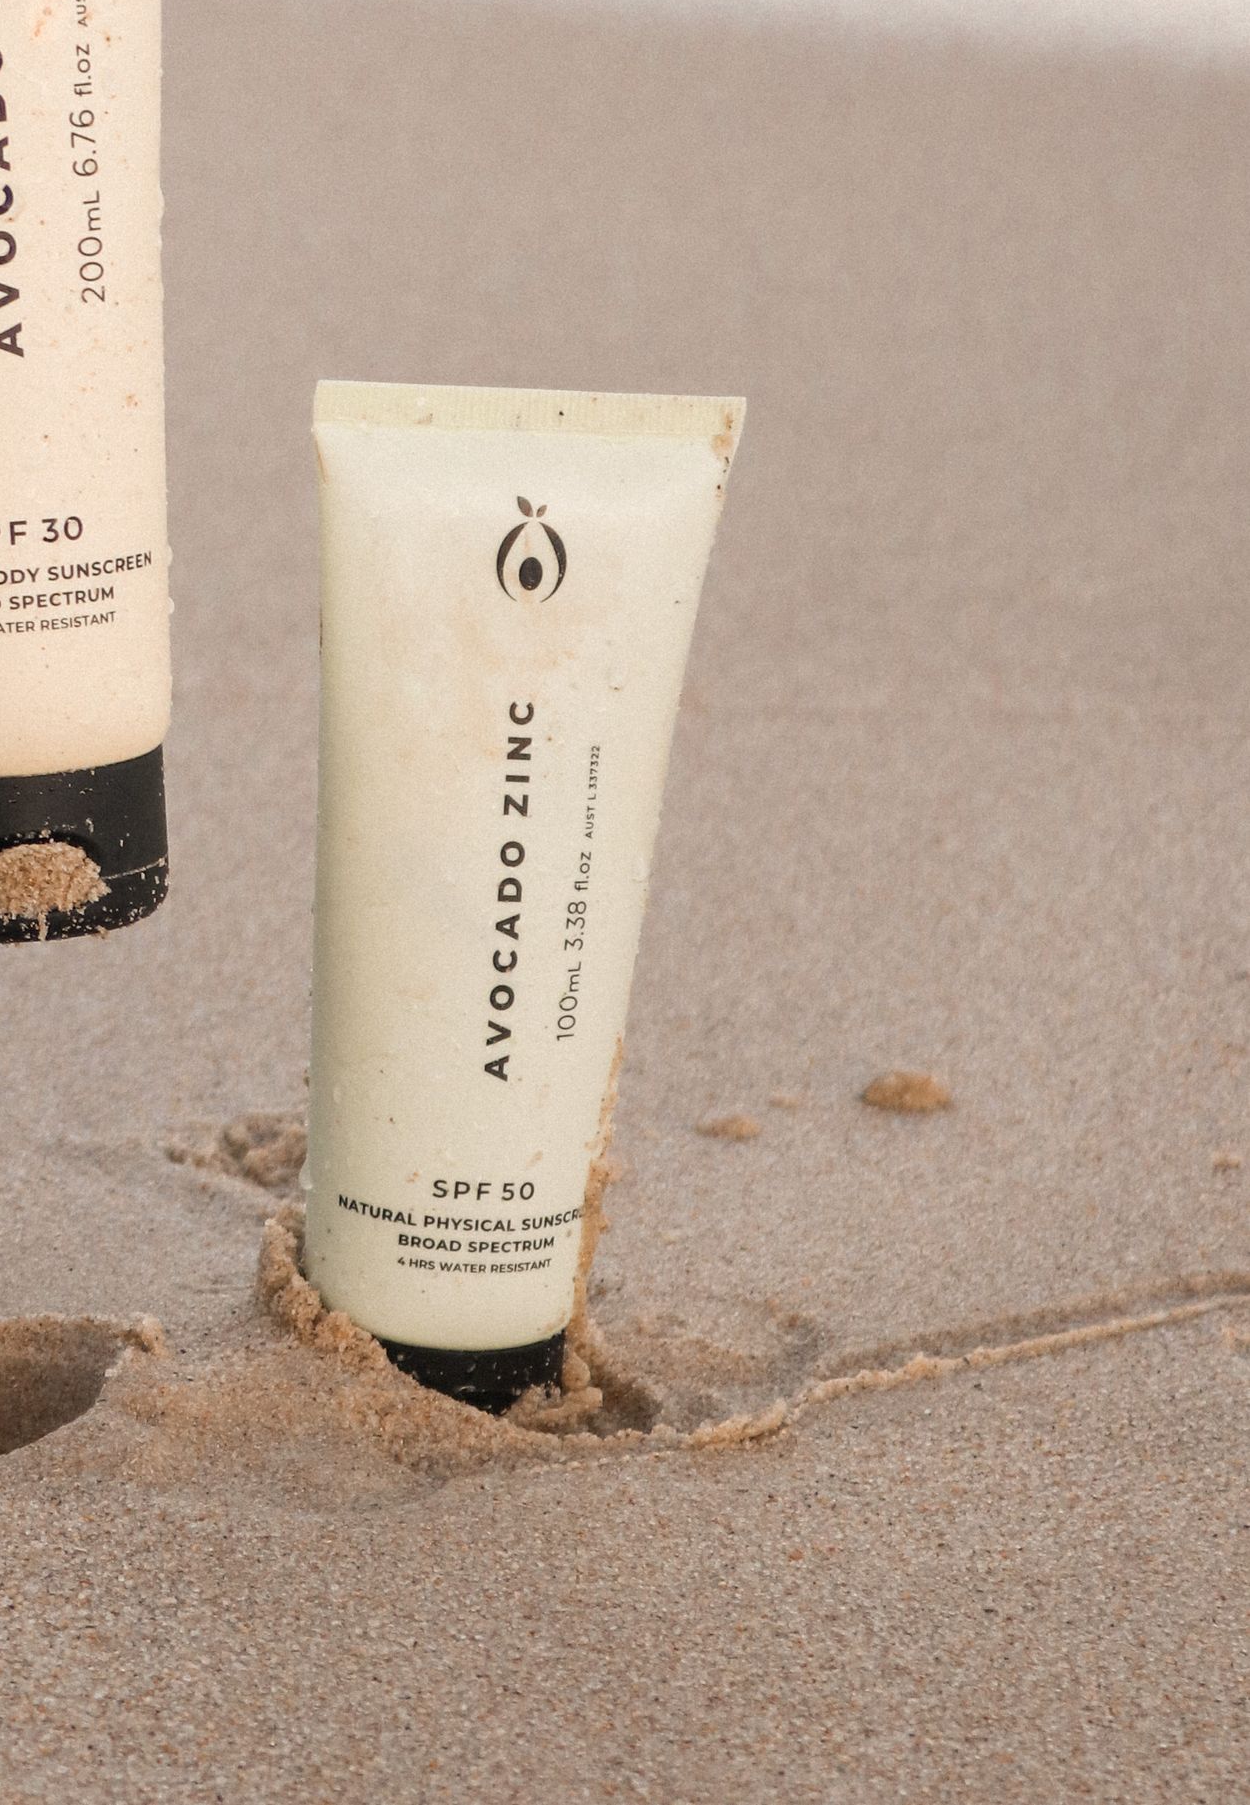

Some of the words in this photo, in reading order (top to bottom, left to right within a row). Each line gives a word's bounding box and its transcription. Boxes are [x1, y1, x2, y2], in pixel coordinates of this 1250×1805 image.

[73, 43, 93, 97] fl.oz
[68, 109, 99, 177] 6.76
[77, 190, 106, 304] 200mL
[41, 515, 83, 544] 30
[47, 551, 152, 582] SUNSCREEN
[8, 586, 115, 611] SPECTRUM
[40, 610, 116, 632] RESISTANT
[502, 701, 535, 818] ZINC
[588, 745, 601, 790] 337322
[586, 793, 597, 801] L
[584, 805, 596, 840] AUST
[573, 851, 592, 892] fl.oz
[563, 900, 587, 951] 3.38
[483, 840, 526, 1082] AVOCADO
[556, 961, 582, 1042] 100mL
[432, 1179, 492, 1201] SPF
[501, 1181, 535, 1202] 50
[338, 1194, 417, 1227] NATURAL
[423, 1214, 516, 1233] PHYSICAL
[397, 1233, 462, 1252] BROAD
[467, 1236, 555, 1254] SPECTRUM
[397, 1256, 406, 1266] 4
[408, 1257, 436, 1271] HRS
[439, 1261, 487, 1274] WATER
[490, 1258, 552, 1274] RESISTANT
